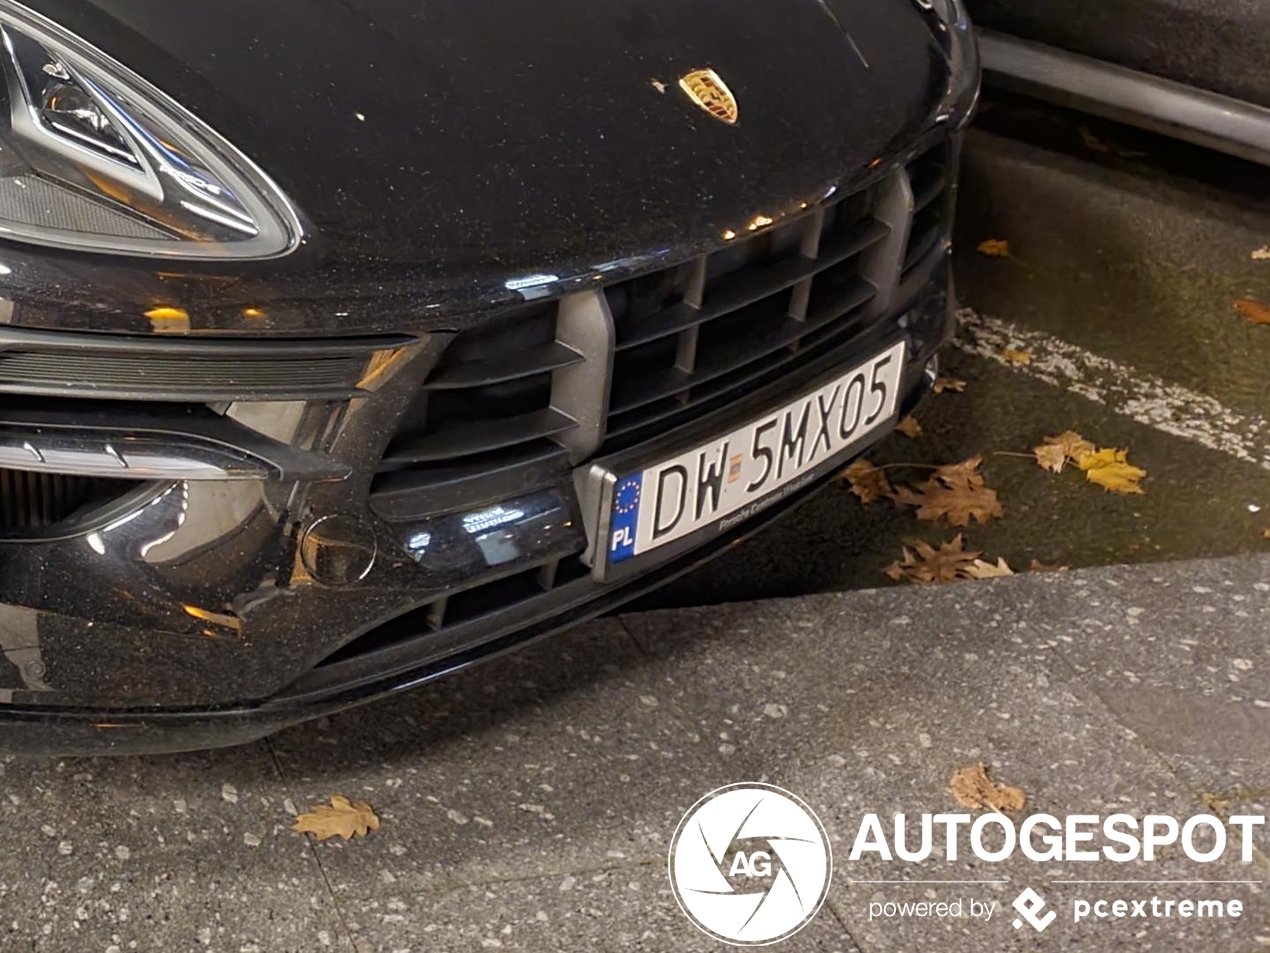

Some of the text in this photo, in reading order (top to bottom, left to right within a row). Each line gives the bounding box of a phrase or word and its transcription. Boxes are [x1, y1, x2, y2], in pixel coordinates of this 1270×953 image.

[651, 354, 892, 541] DW 5MX05
[611, 525, 633, 551] PL
